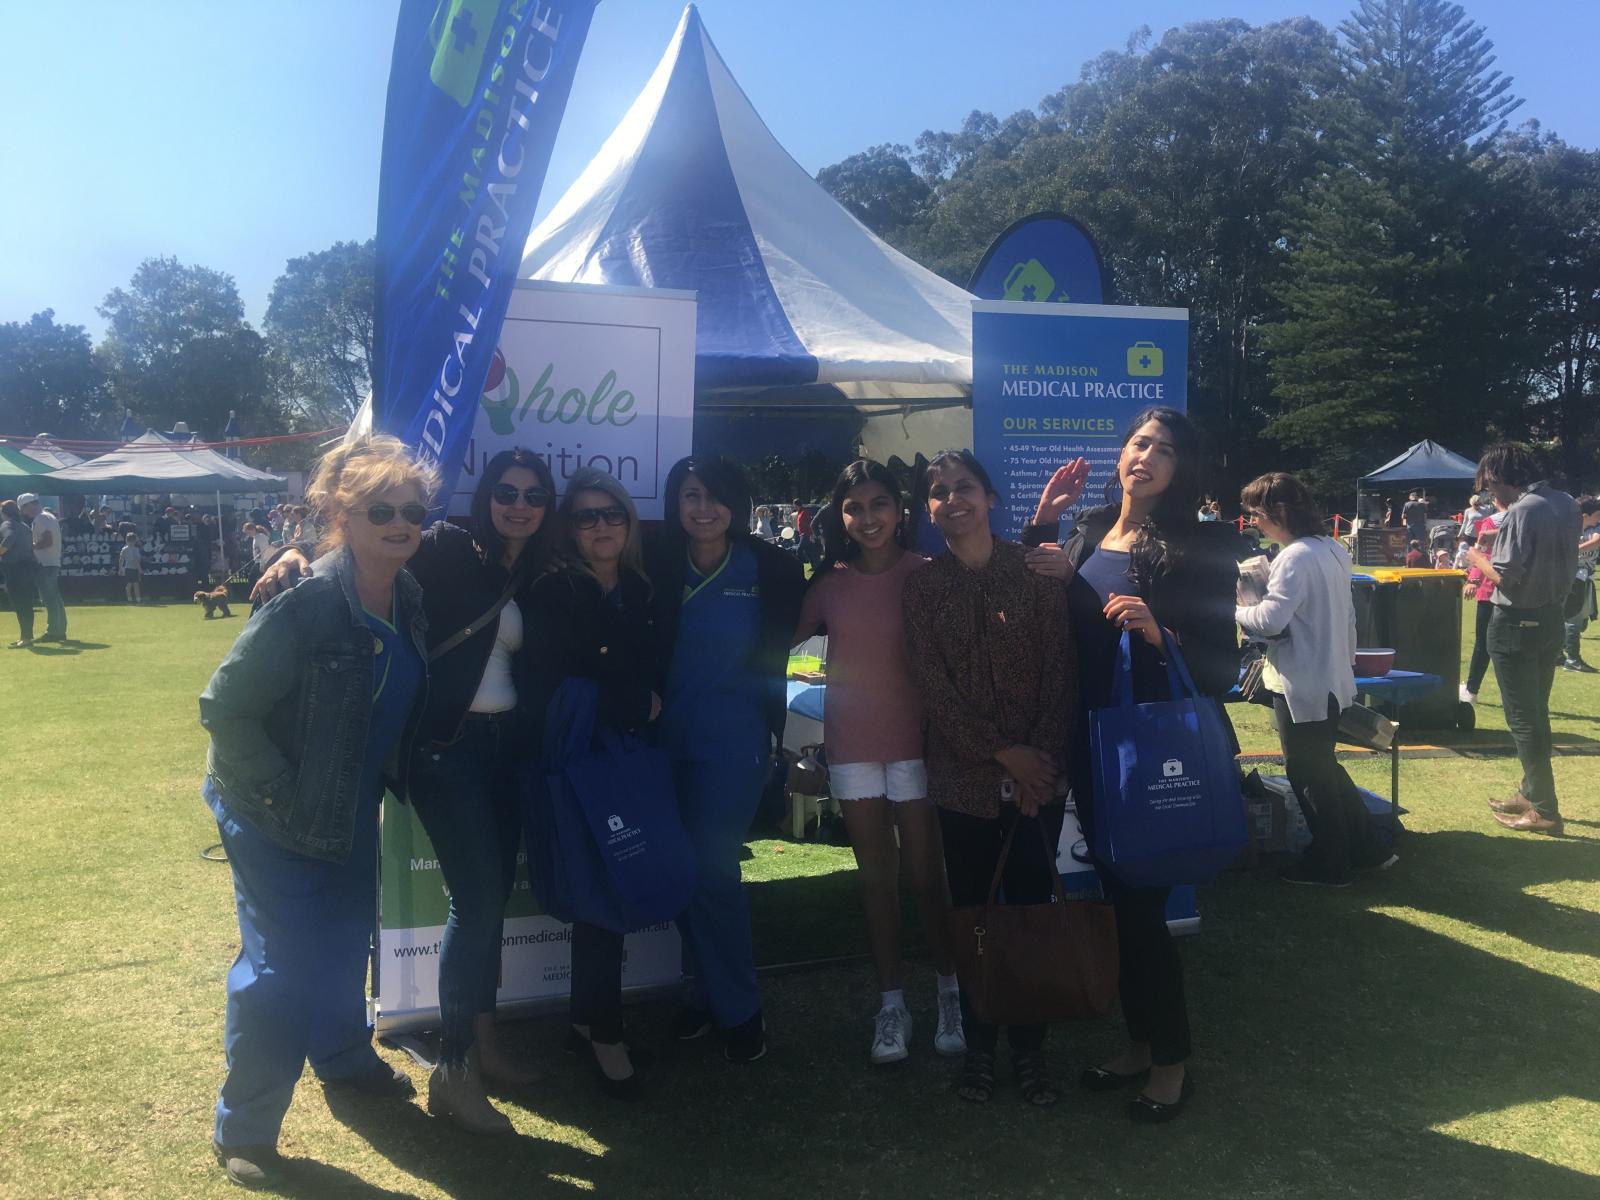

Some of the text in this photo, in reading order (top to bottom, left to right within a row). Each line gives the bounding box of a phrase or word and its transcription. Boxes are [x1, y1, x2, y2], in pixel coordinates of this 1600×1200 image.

[468, 0, 563, 290] PRACTICE
[435, 225, 464, 300] THE
[1003, 364, 1098, 377] THE MADISON
[1002, 380, 1164, 399] MEDICAL PRACTICE
[1003, 417, 1114, 431] OUR SERVICES
[1010, 457, 1020, 465] 75
[1147, 779, 1200, 791] MEDICAL PRACTICE
